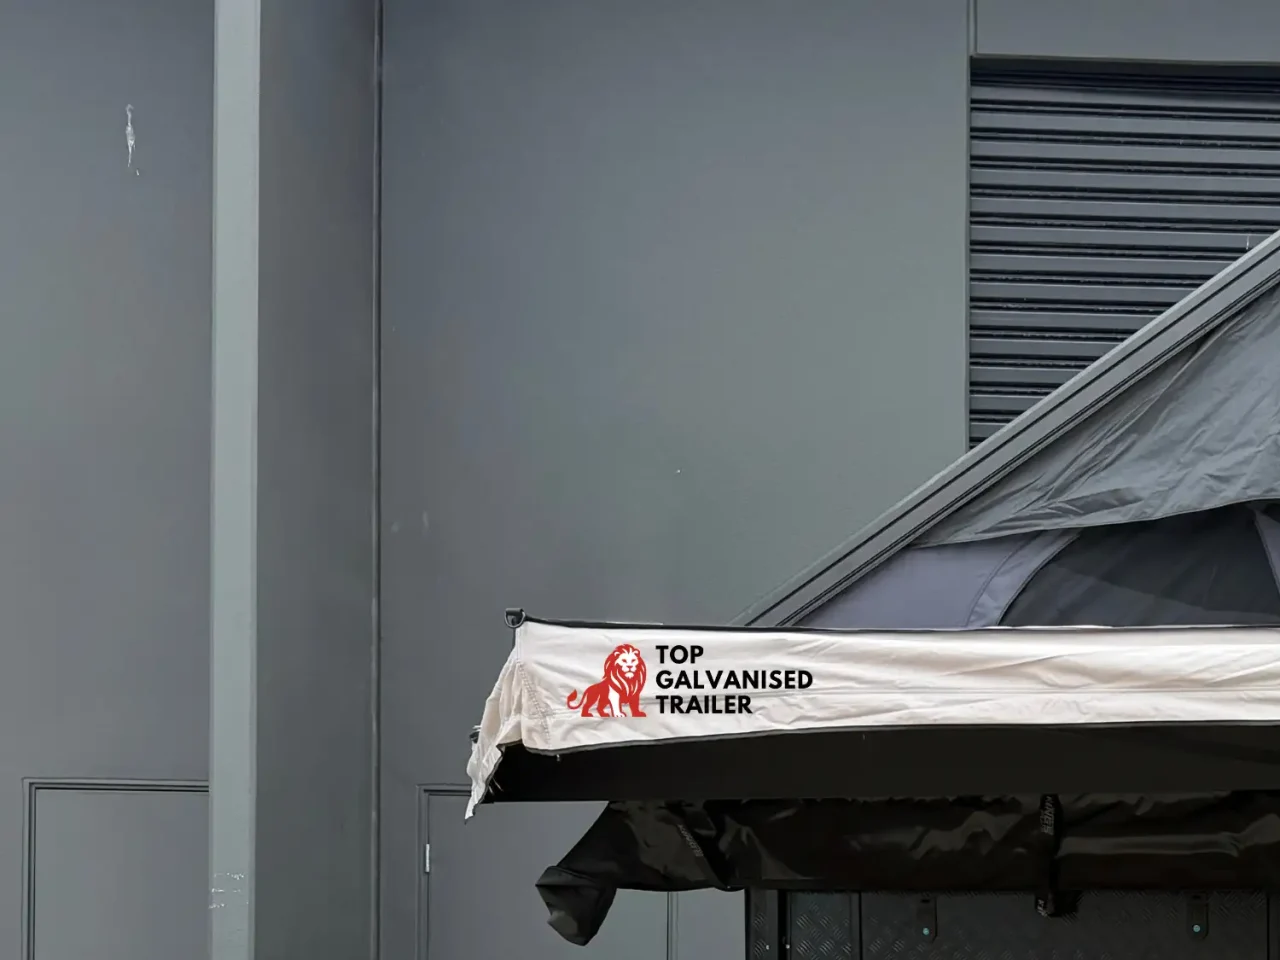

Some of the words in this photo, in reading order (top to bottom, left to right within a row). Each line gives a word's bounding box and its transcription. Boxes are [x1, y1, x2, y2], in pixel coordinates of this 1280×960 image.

[655, 644, 704, 665] TOP
[655, 669, 813, 690] GALVANISED
[655, 695, 753, 715] TRAILER
